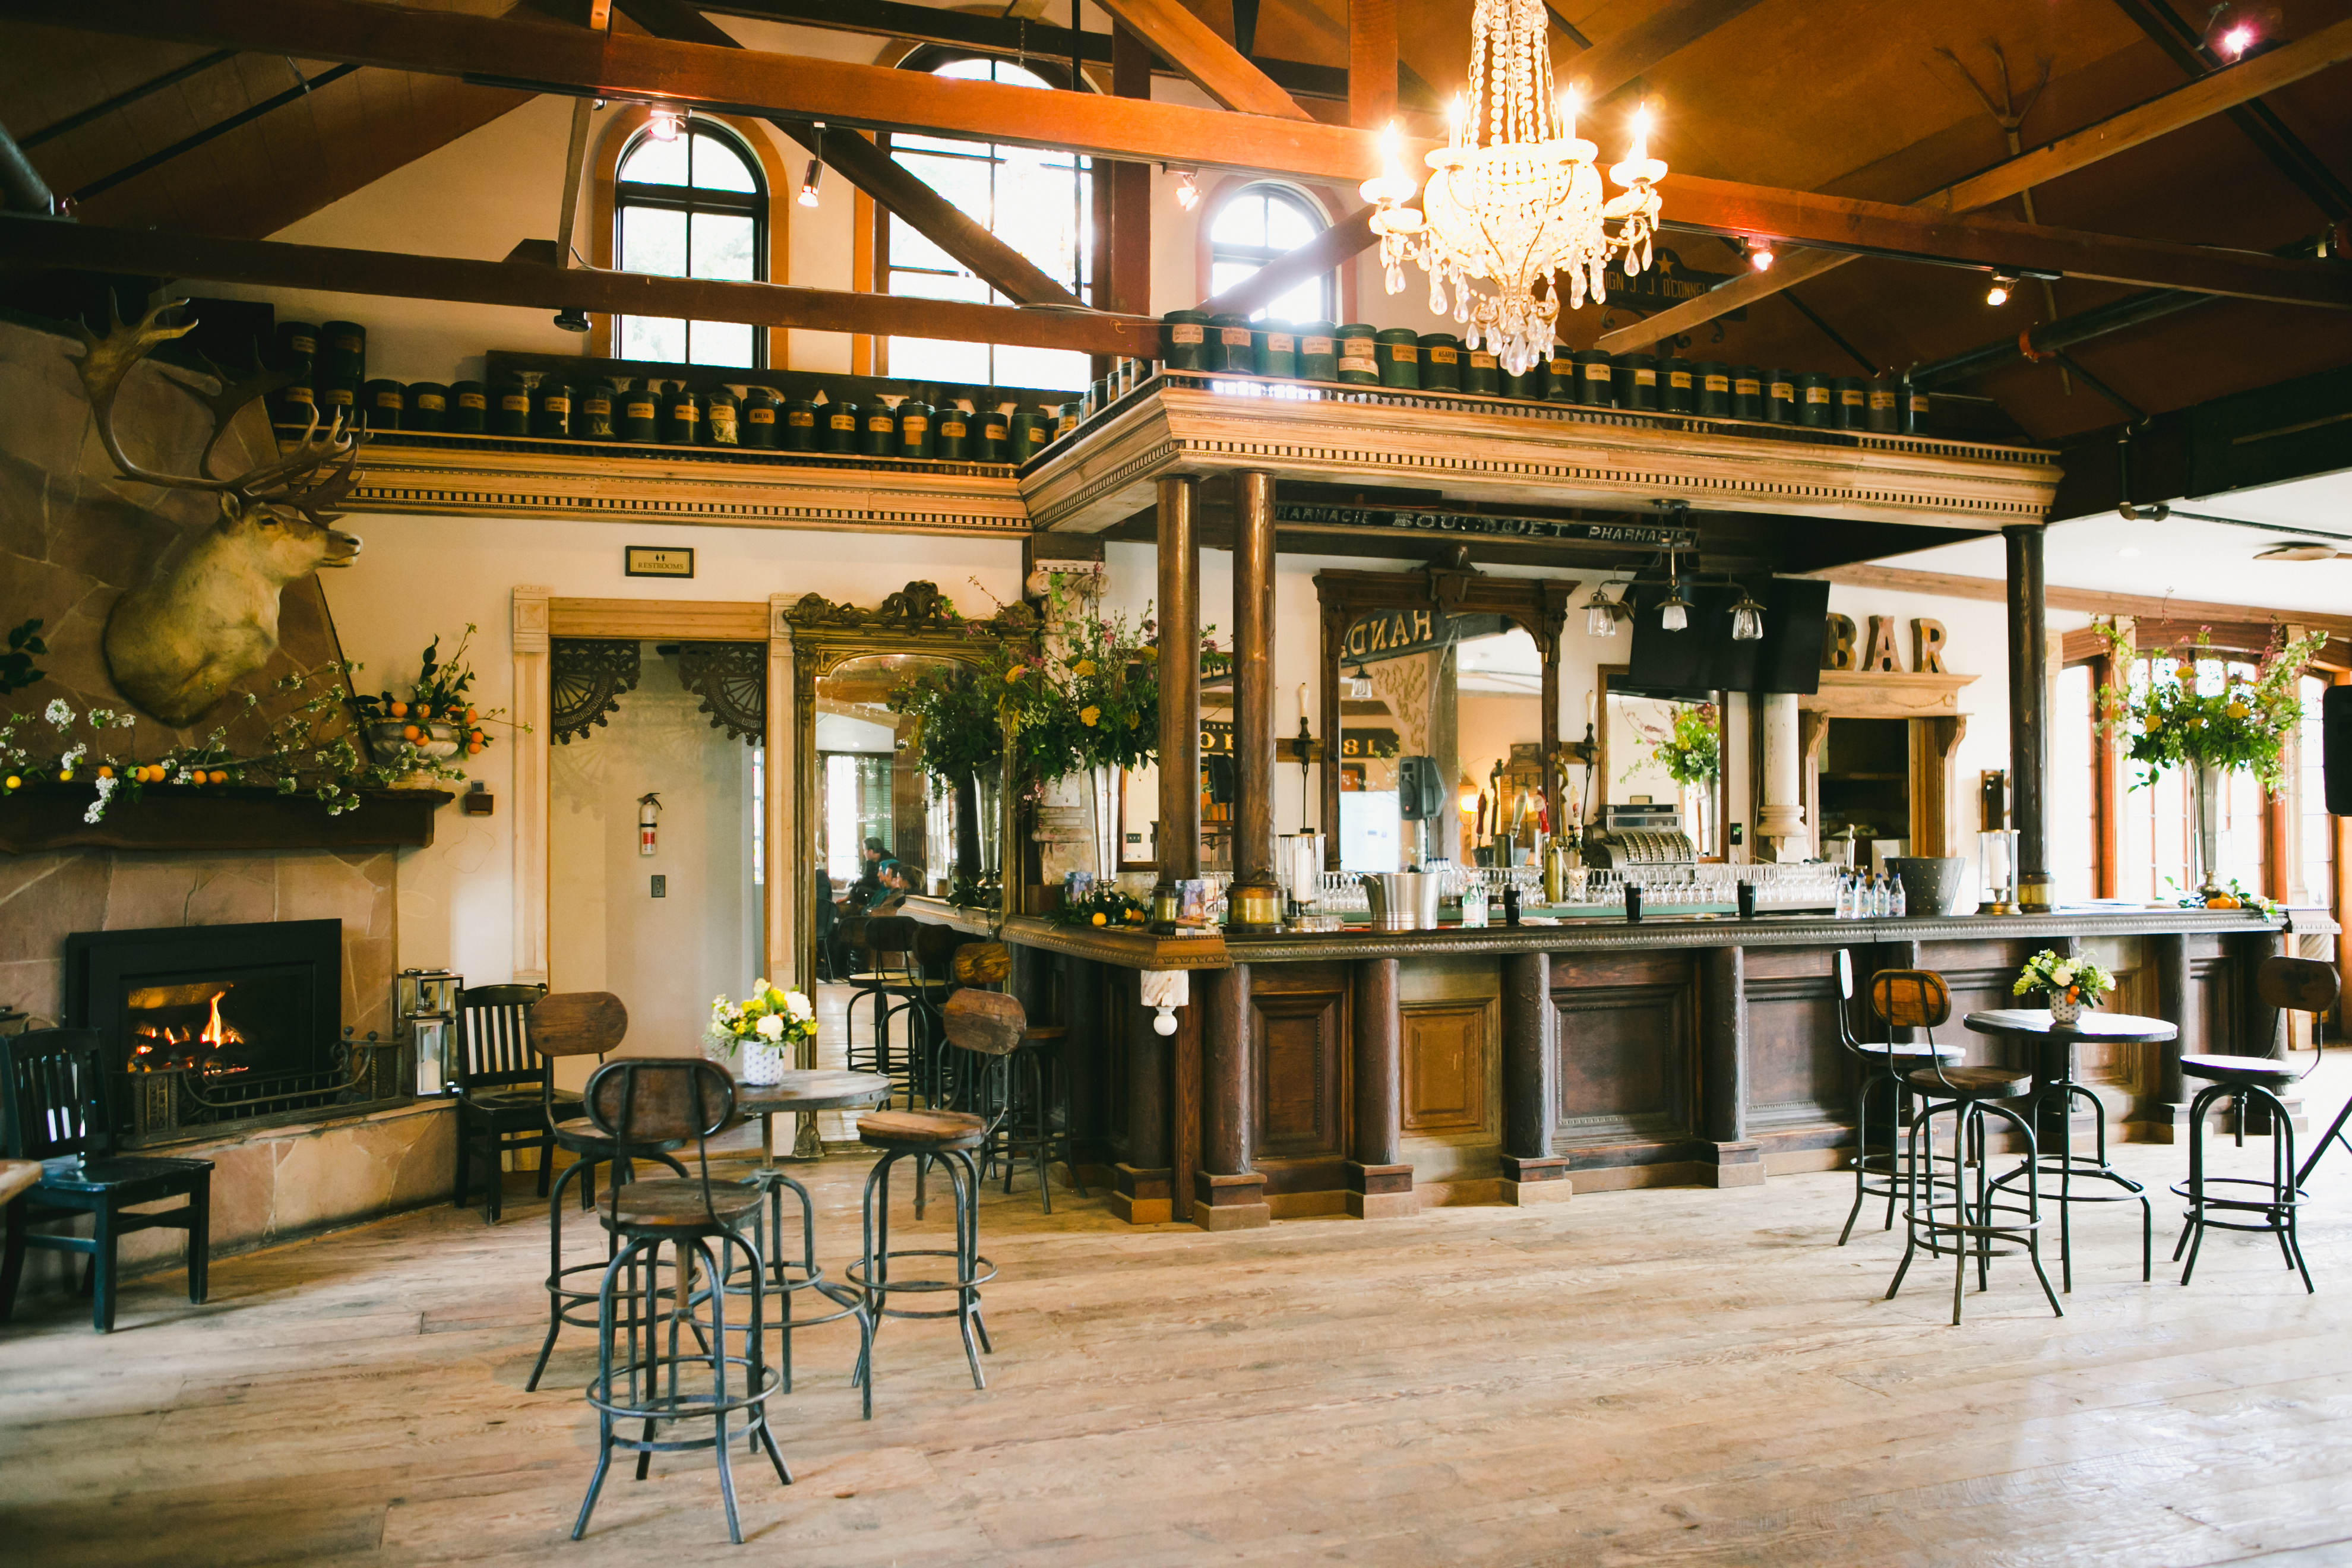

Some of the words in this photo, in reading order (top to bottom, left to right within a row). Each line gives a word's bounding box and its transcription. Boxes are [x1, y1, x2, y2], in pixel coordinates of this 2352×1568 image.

[1551, 362, 1572, 371] HYSSOP
[1275, 506, 1373, 524] HARMACIE
[1822, 612, 1948, 674] BAR
